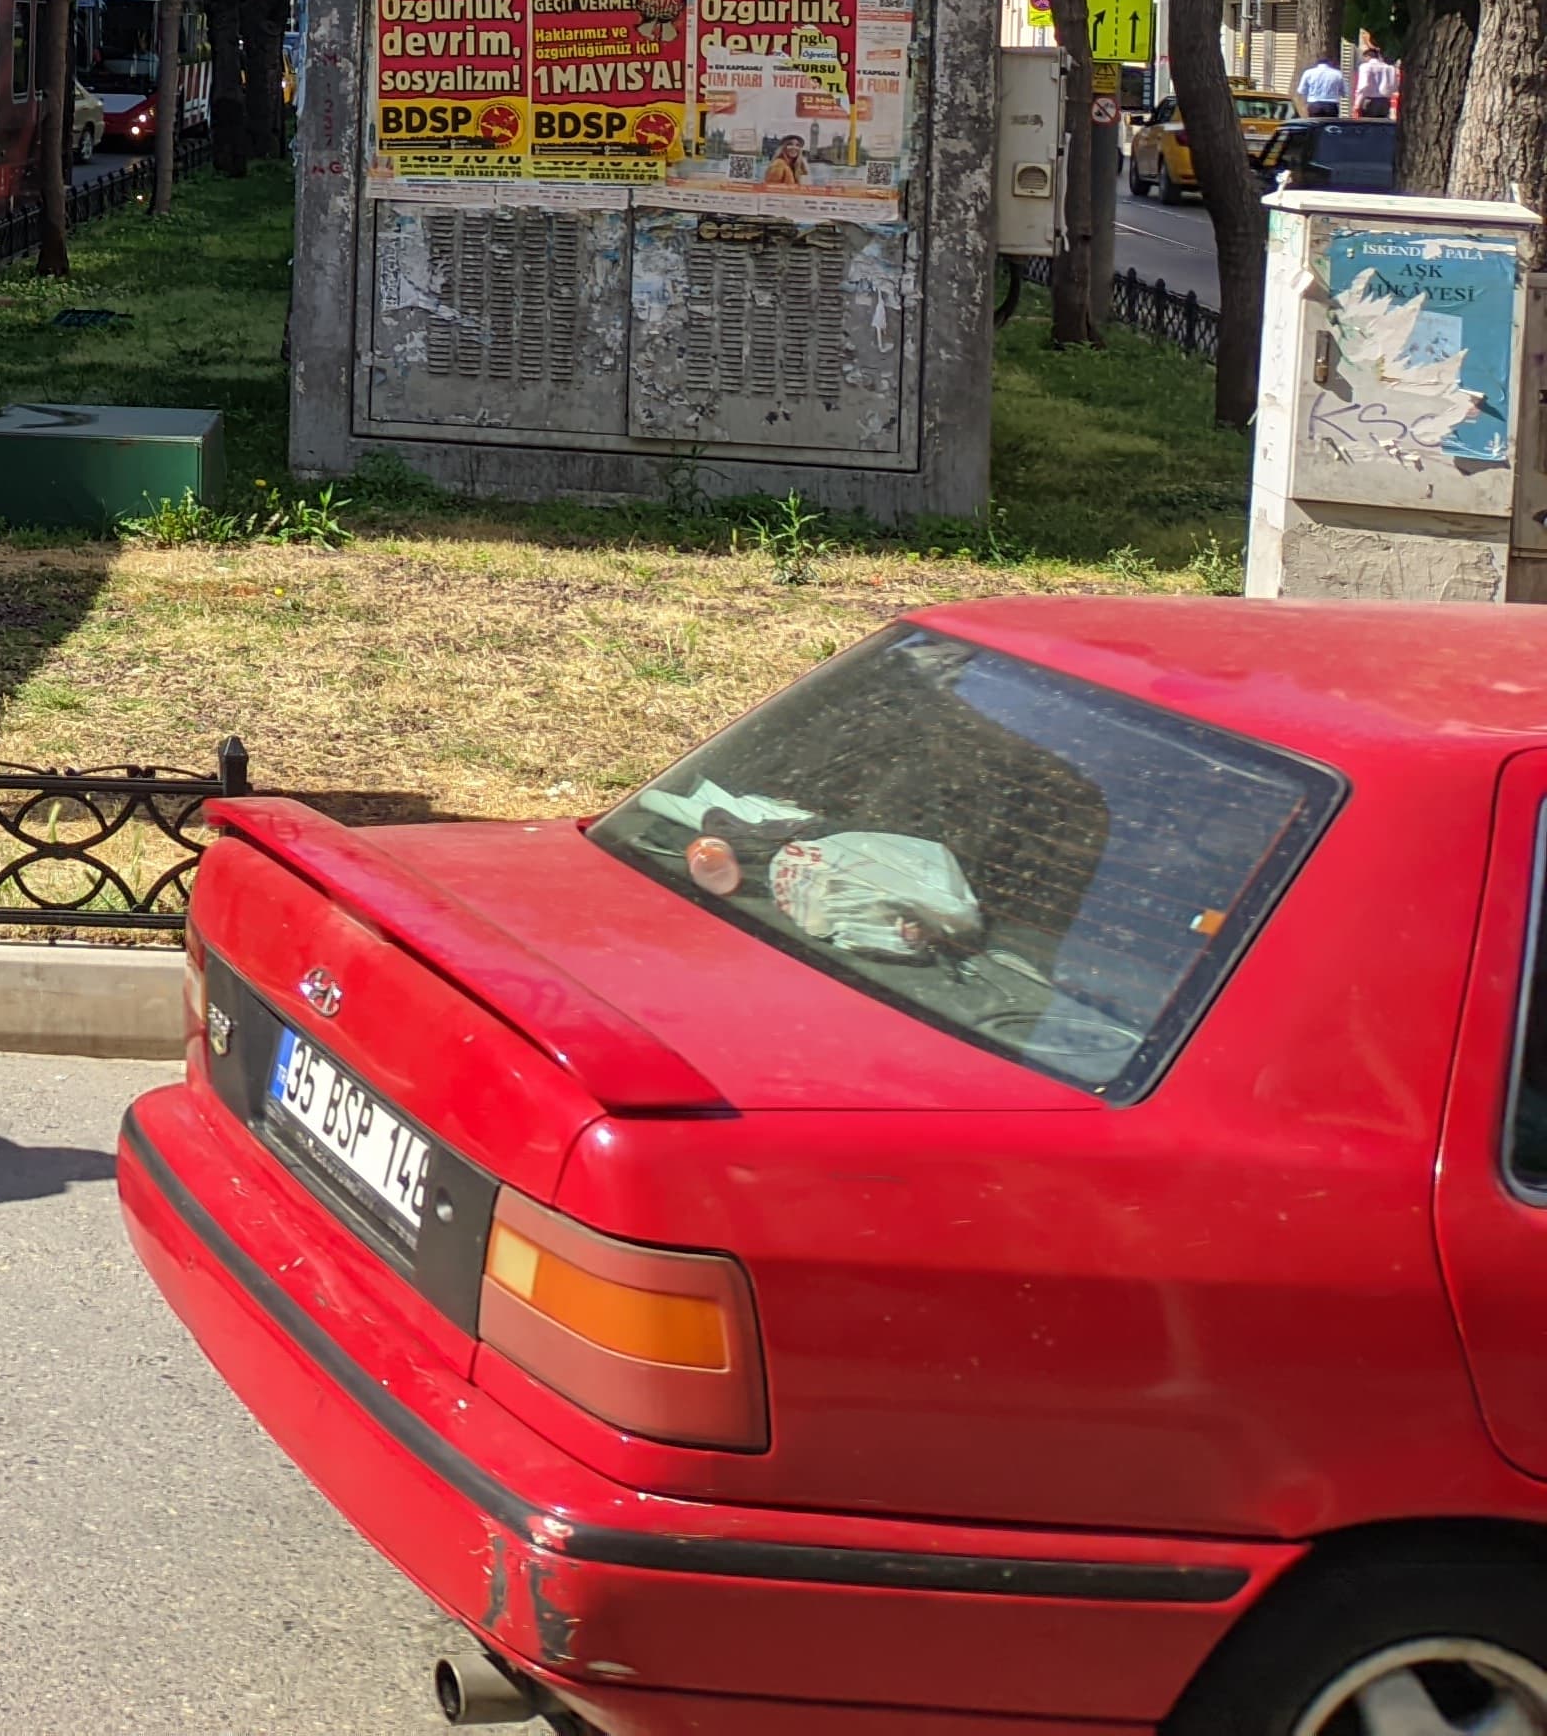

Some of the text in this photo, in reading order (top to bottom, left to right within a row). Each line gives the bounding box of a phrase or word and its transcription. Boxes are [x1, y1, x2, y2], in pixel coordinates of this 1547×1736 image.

[382, 25, 521, 59] devrim,
[535, 26, 628, 43] Haklarımız ve
[535, 41, 632, 60] özgürlüğümüz
[381, 64, 521, 94] sosyalizm!
[731, 72, 763, 88] FUARI
[827, 82, 844, 94] TL
[382, 106, 472, 133] BDSP
[535, 112, 627, 139] BDSP
[1363, 242, 1484, 261] İSKEND PALA
[1398, 263, 1444, 280] AŞK
[287, 1040, 321, 1114] 35
[322, 1070, 374, 1159] BSP
